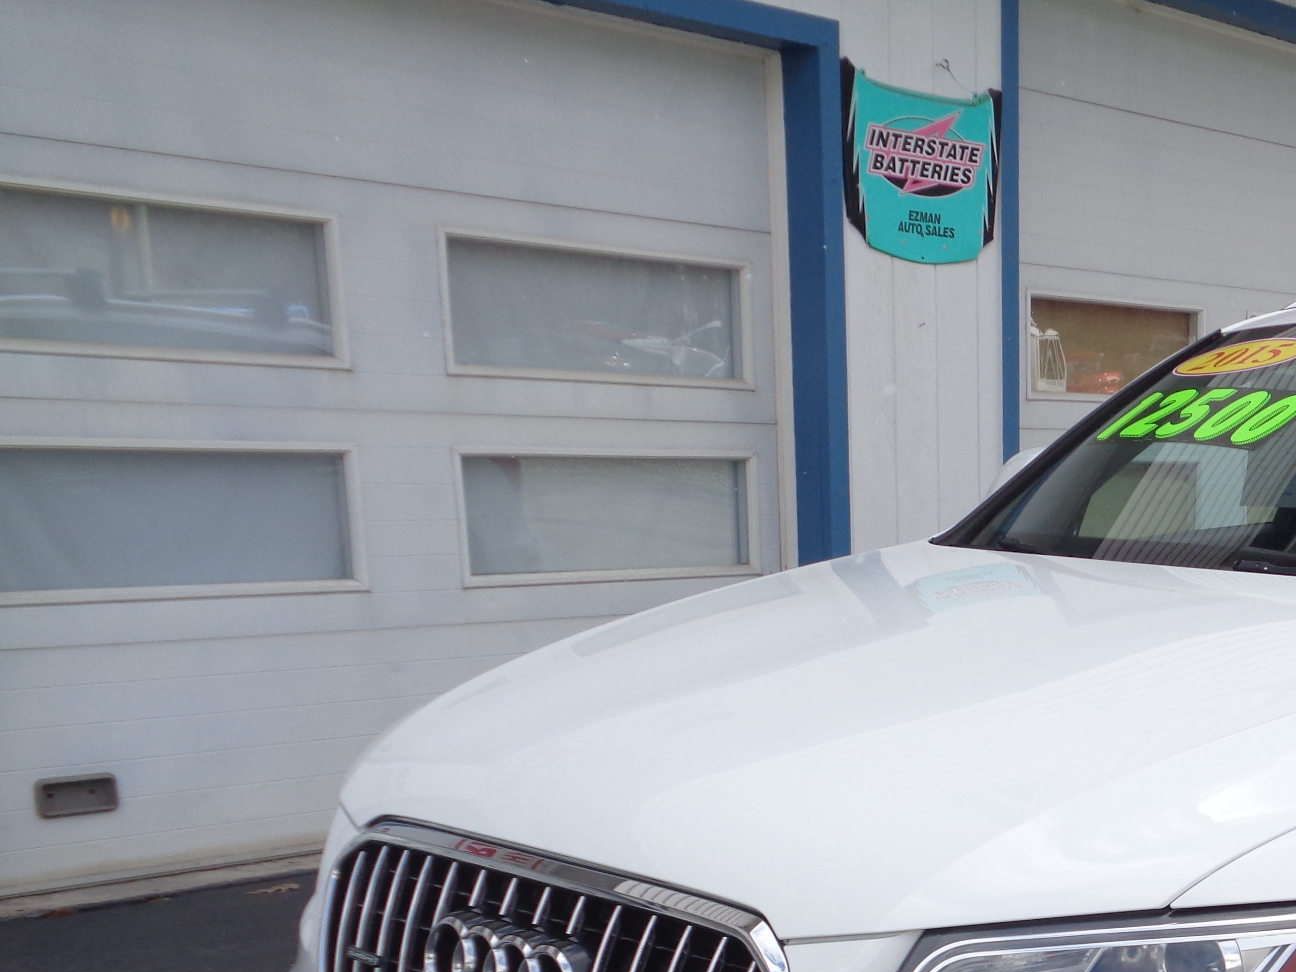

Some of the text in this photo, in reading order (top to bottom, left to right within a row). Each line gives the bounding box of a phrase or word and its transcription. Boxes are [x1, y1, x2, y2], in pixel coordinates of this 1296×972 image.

[868, 128, 981, 164] INTERSTATE
[871, 153, 974, 186] BATTERIES
[897, 221, 955, 239] AUTO SALES
[908, 210, 941, 225] EZMAN
[1187, 342, 1296, 372] 2015
